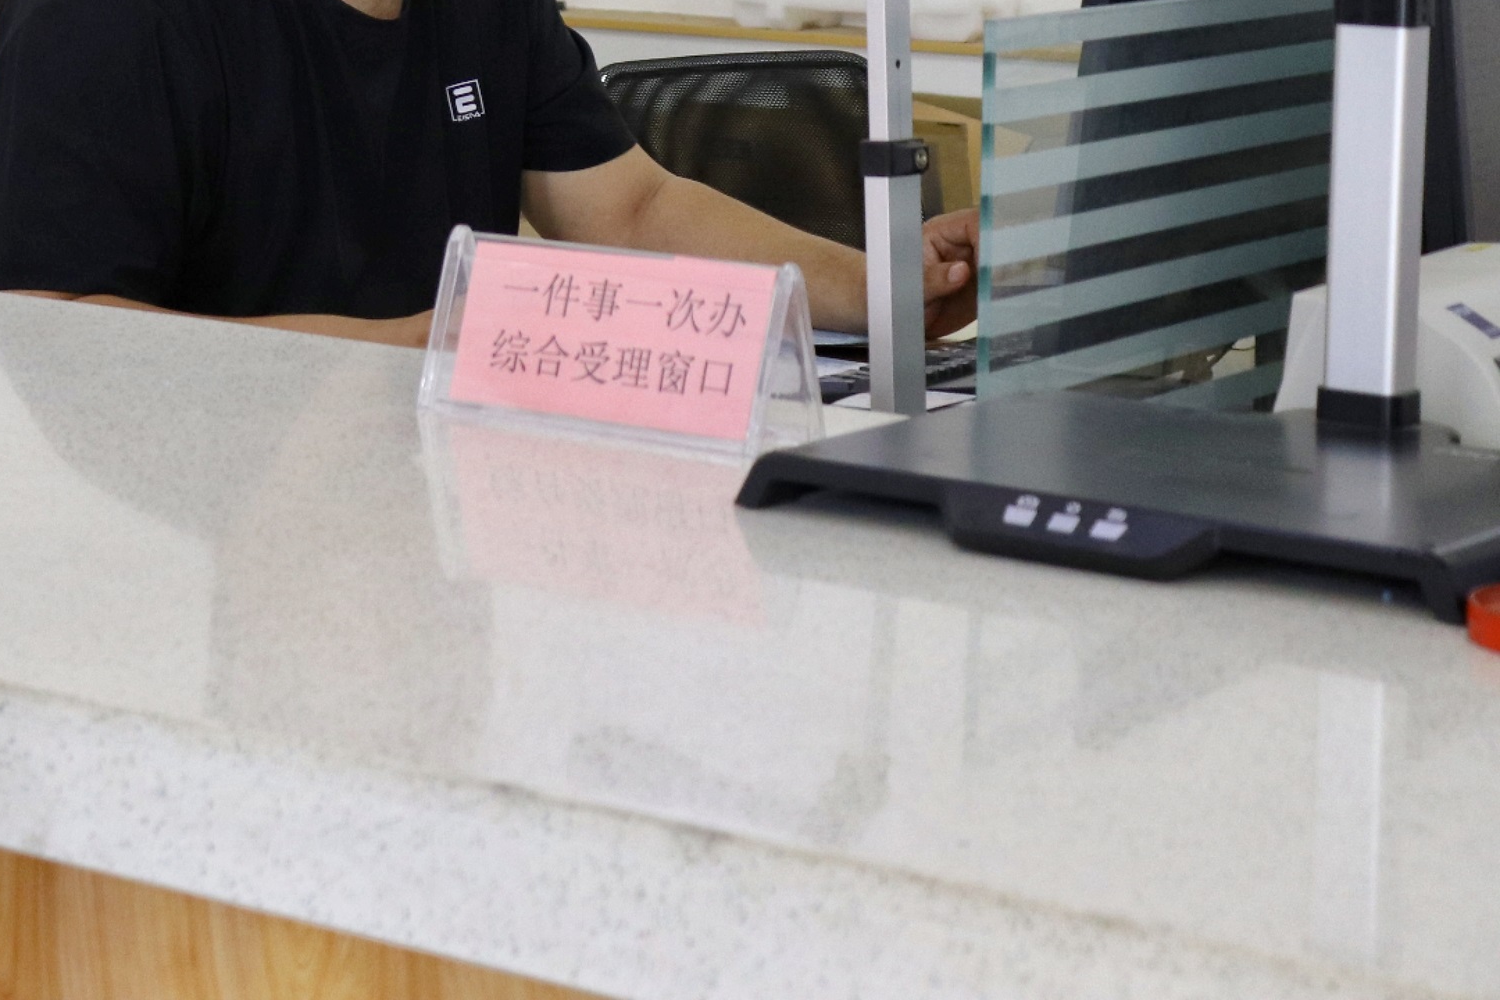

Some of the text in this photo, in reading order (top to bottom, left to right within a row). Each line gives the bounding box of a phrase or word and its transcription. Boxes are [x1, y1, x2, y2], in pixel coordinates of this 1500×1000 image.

[503, 272, 748, 338] 一件事一次办
[488, 329, 734, 396] 综合受理窗口
